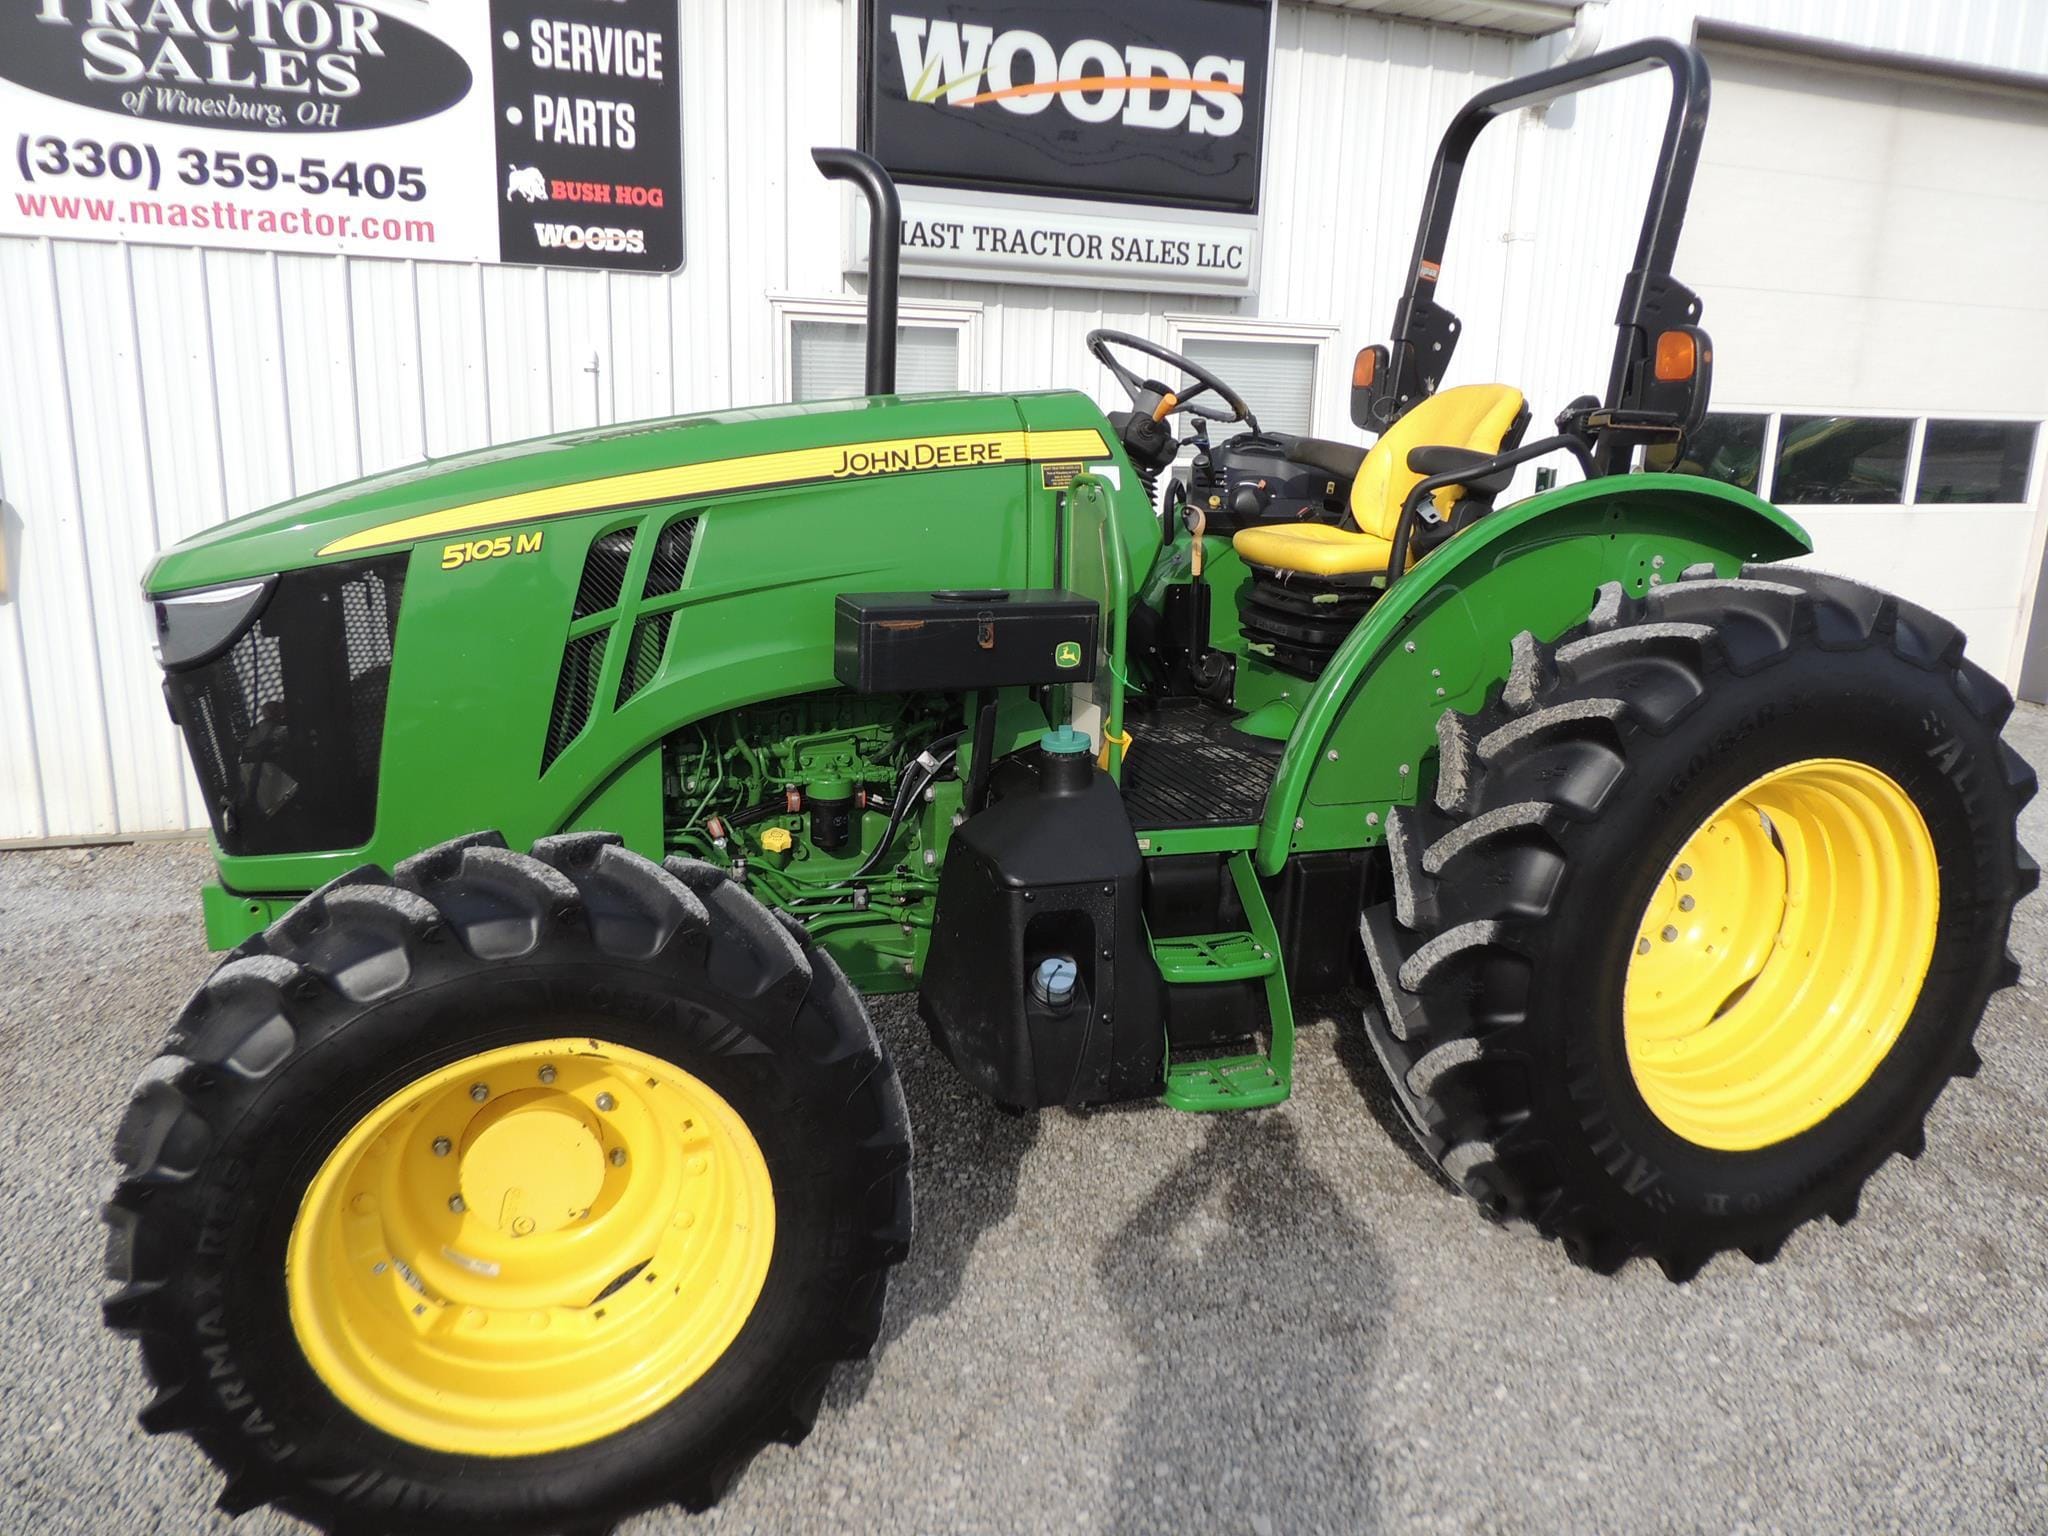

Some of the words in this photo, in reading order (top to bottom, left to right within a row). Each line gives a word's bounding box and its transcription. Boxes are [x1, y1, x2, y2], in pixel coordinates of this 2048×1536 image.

[82, 27, 361, 97] SALES
[530, 18, 664, 81] SERVICE
[890, 14, 1246, 137] WOODS
[121, 87, 152, 115] of
[154, 87, 288, 126] Winesburg,
[296, 100, 343, 127] OH
[533, 94, 636, 150] PARTS
[16, 134, 161, 190] (330)
[178, 147, 427, 202] 359-5405
[551, 180, 611, 204] BUSH
[615, 185, 664, 208] HOG
[15, 191, 437, 243] www.masttractor.com
[534, 222, 646, 254] WOODS
[972, 225, 1103, 261] TRACTOR
[1110, 237, 1190, 266] SALES
[1196, 243, 1244, 270] LLC
[833, 449, 910, 475] JOHN
[915, 442, 1003, 466] DEERE
[441, 536, 513, 571] 5105
[516, 531, 545, 555] M
[193, 1272, 298, 1466] FARMAX
